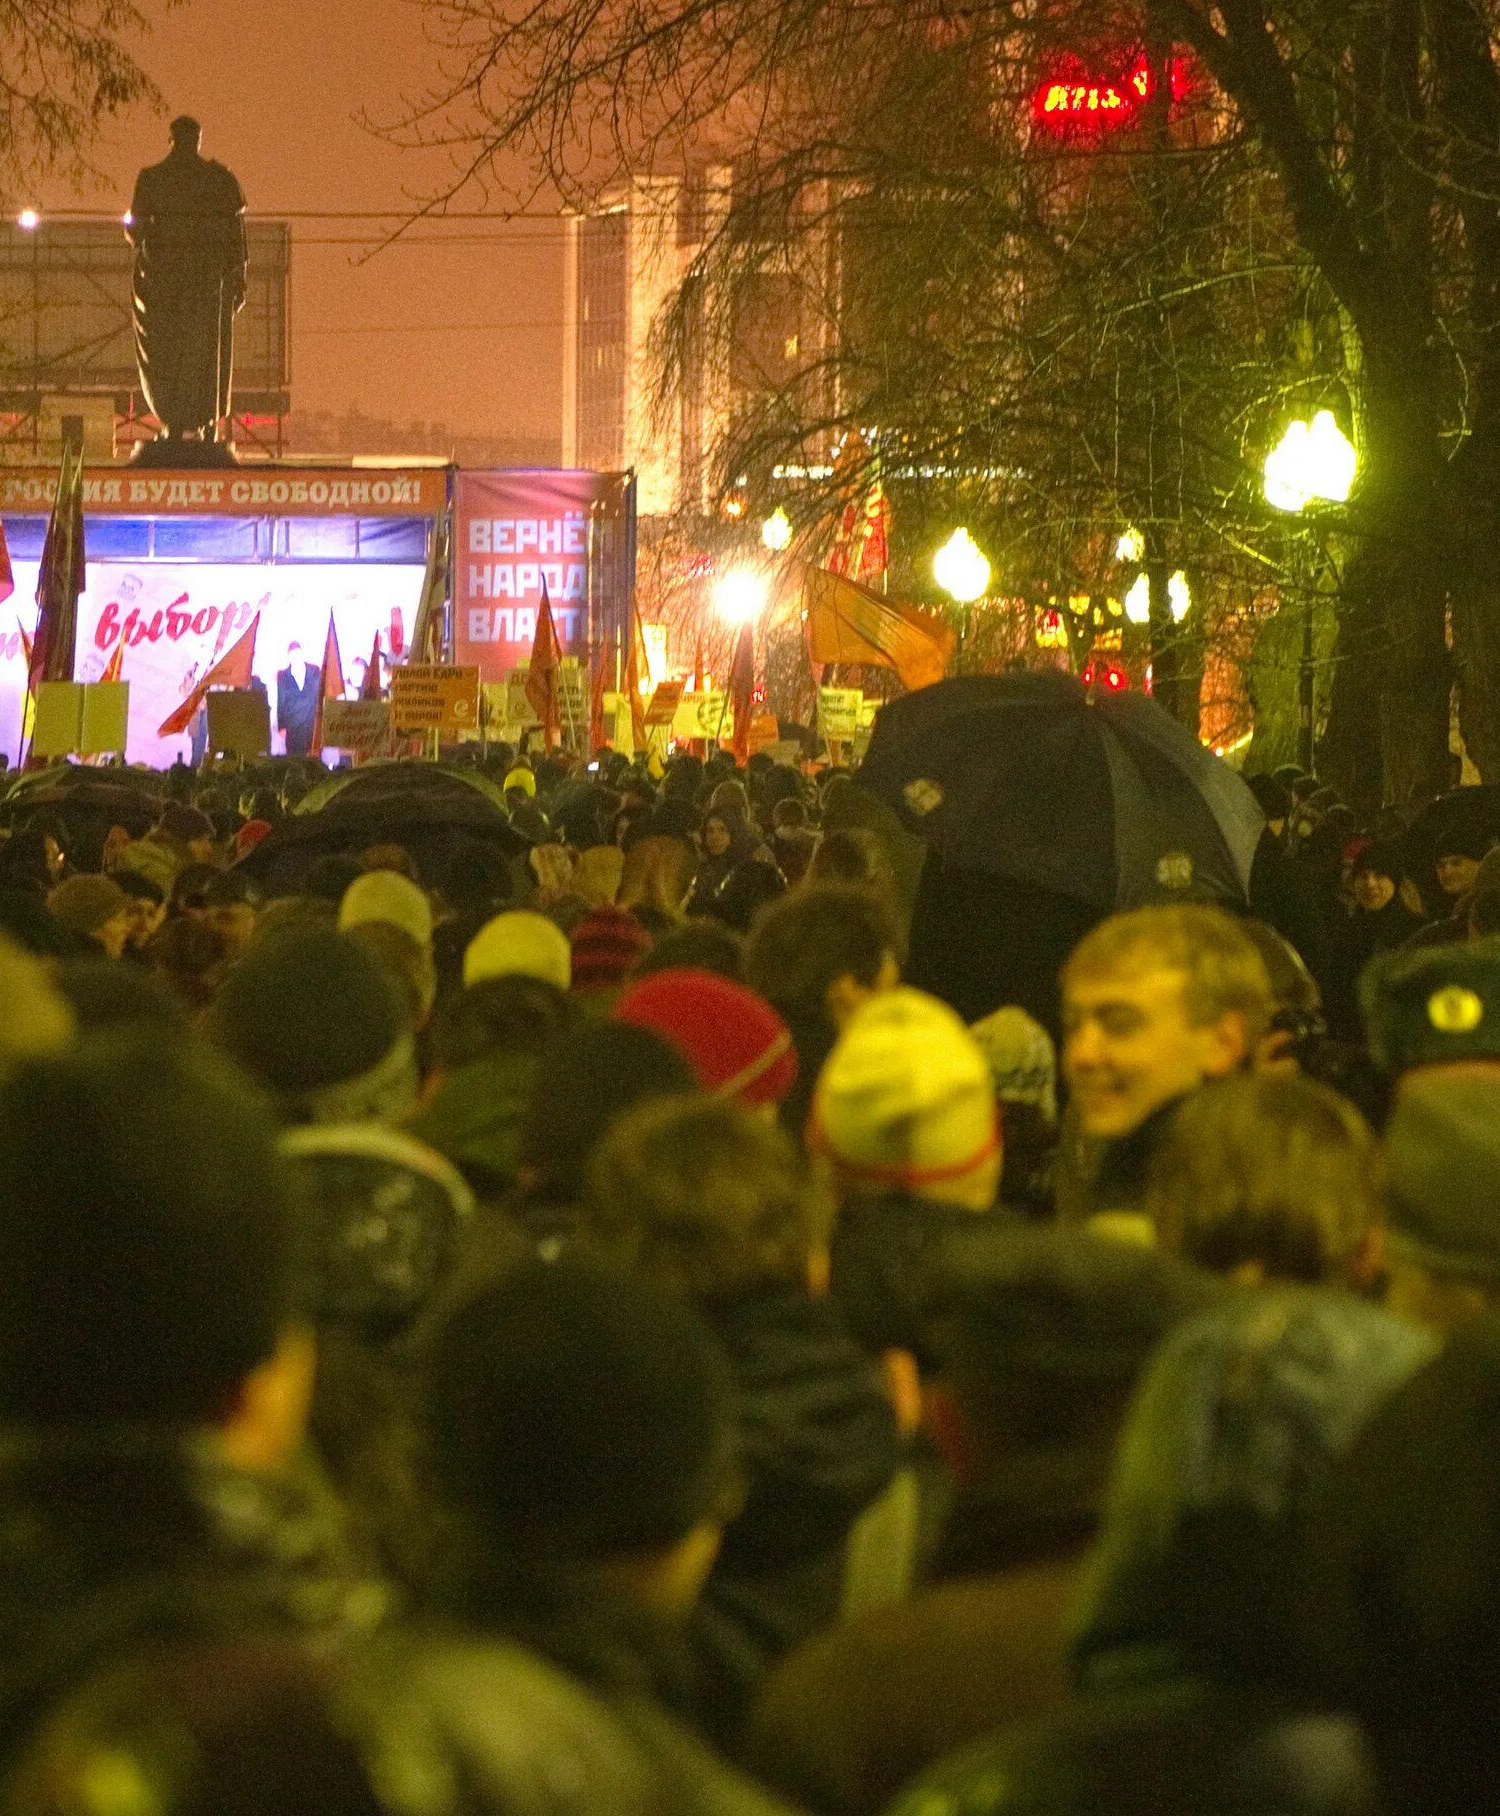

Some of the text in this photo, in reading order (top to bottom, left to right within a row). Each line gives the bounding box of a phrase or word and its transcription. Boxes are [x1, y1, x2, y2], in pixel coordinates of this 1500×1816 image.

[4, 475, 422, 508] РОСИЯ БУДЕТ СВОБОДНОЙ!
